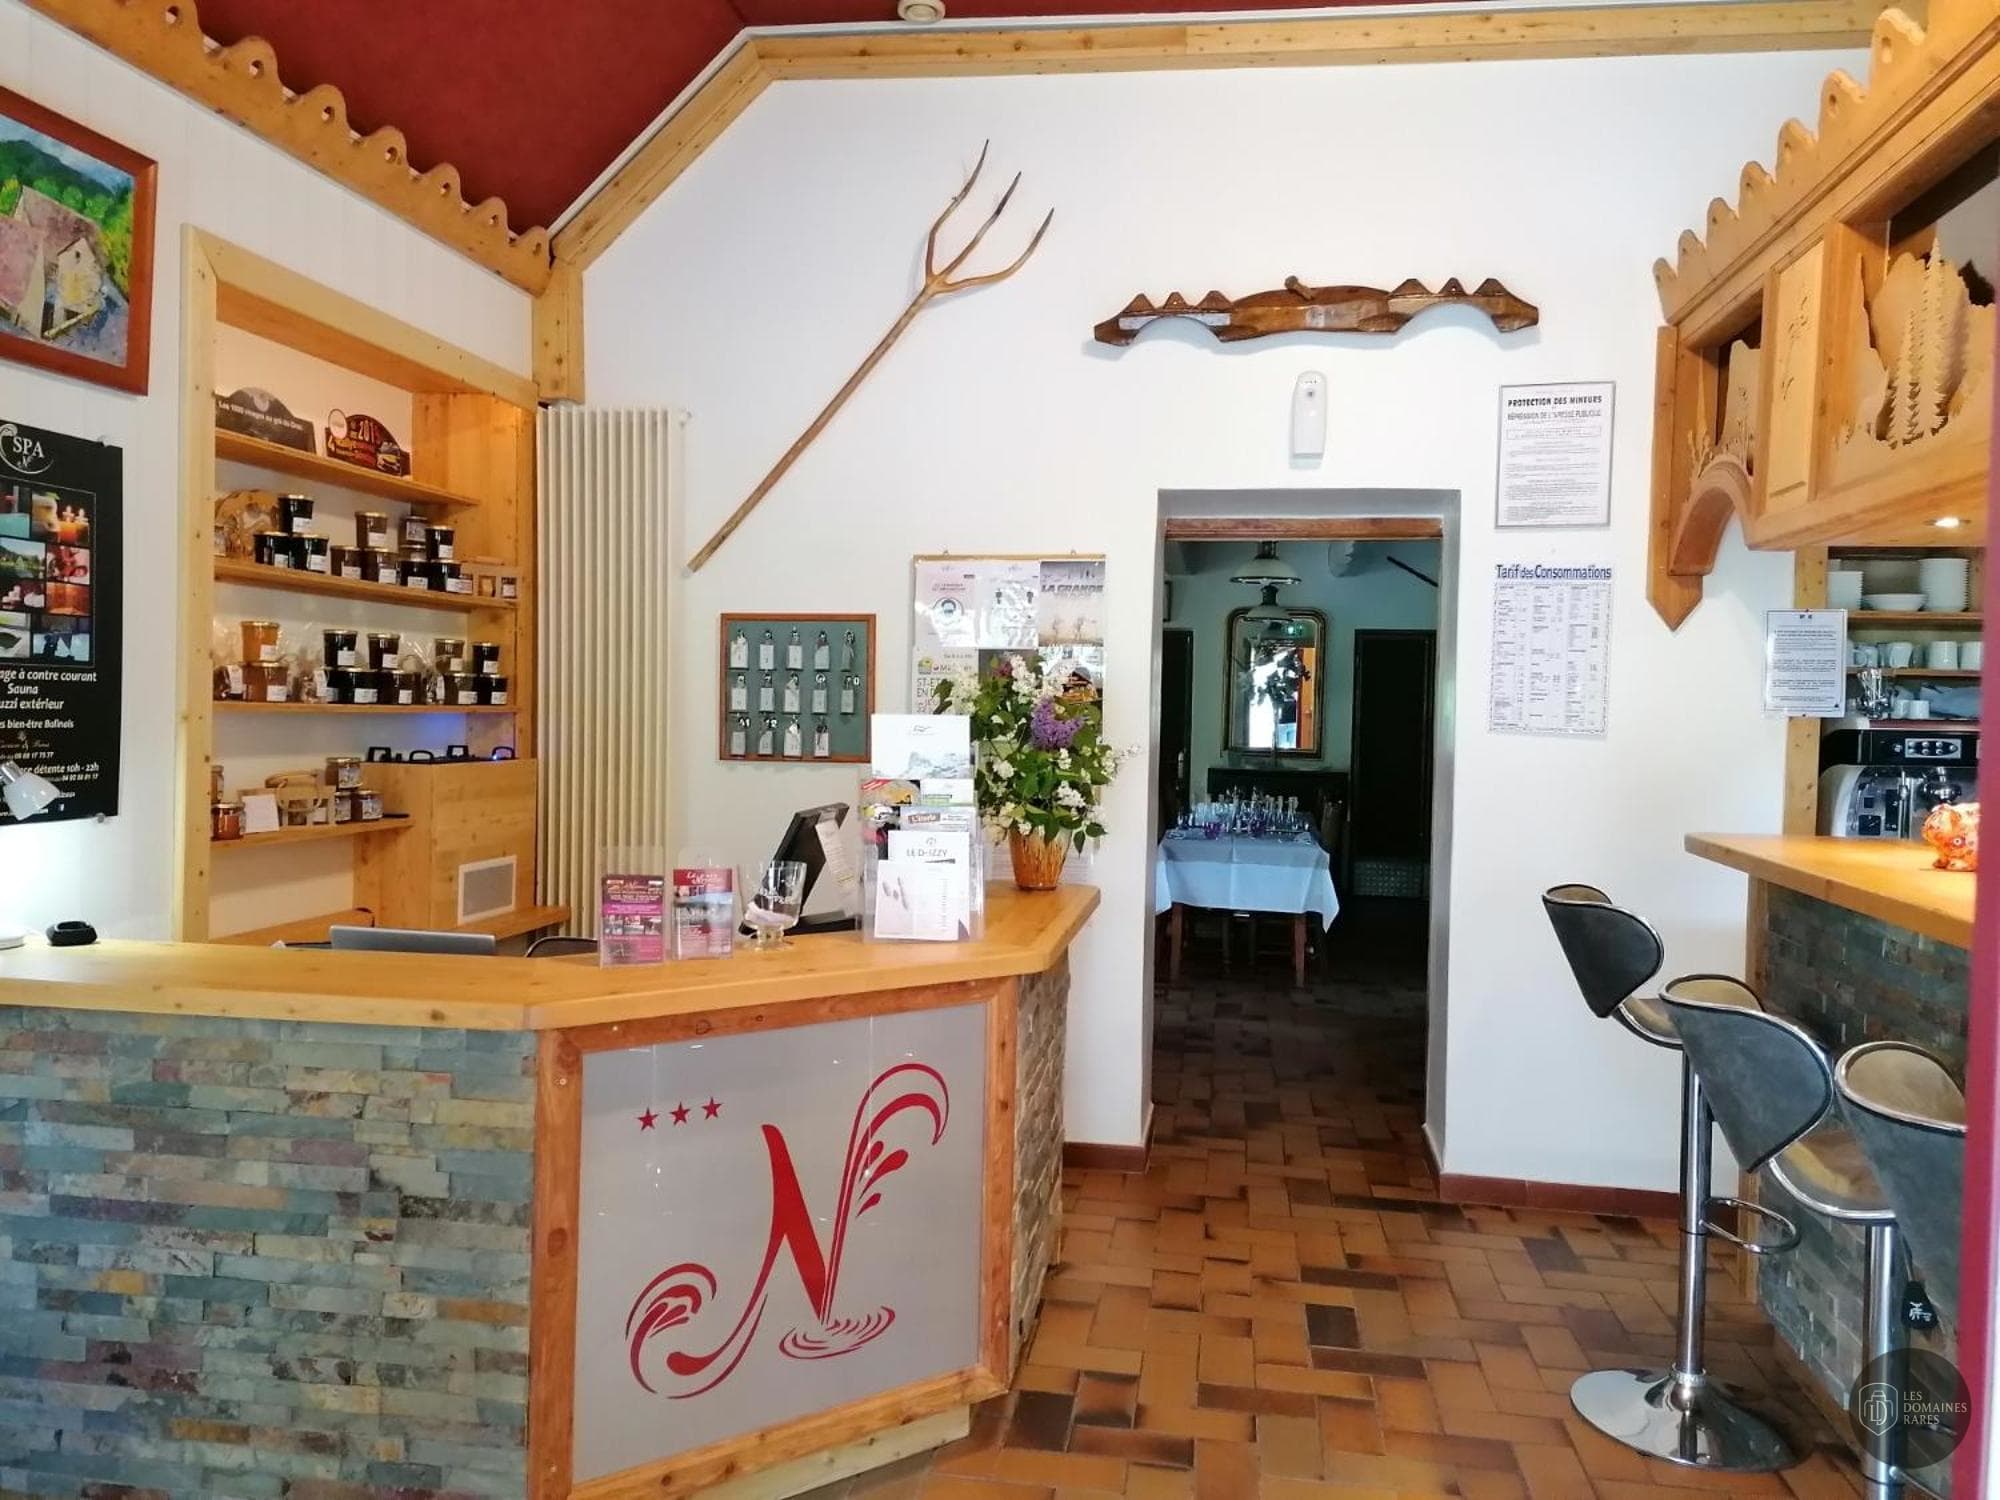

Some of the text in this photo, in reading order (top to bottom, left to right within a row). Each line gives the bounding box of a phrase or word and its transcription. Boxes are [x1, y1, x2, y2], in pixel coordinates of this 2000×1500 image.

[1508, 395, 1602, 407] PROTECTION DES MINEURS
[13, 437, 45, 458] SPA
[1496, 564, 1611, 579] Tarif des Consommations
[18, 668, 26, 680] à
[27, 670, 59, 681] contre
[60, 672, 97, 682] courant
[7, 683, 39, 694] Sauna
[19, 697, 65, 710] extérieur
[7, 719, 43, 729] bien-être
[34, 764, 65, 774] détente
[66, 762, 80, 773] 10h
[85, 761, 99, 772] 22h
